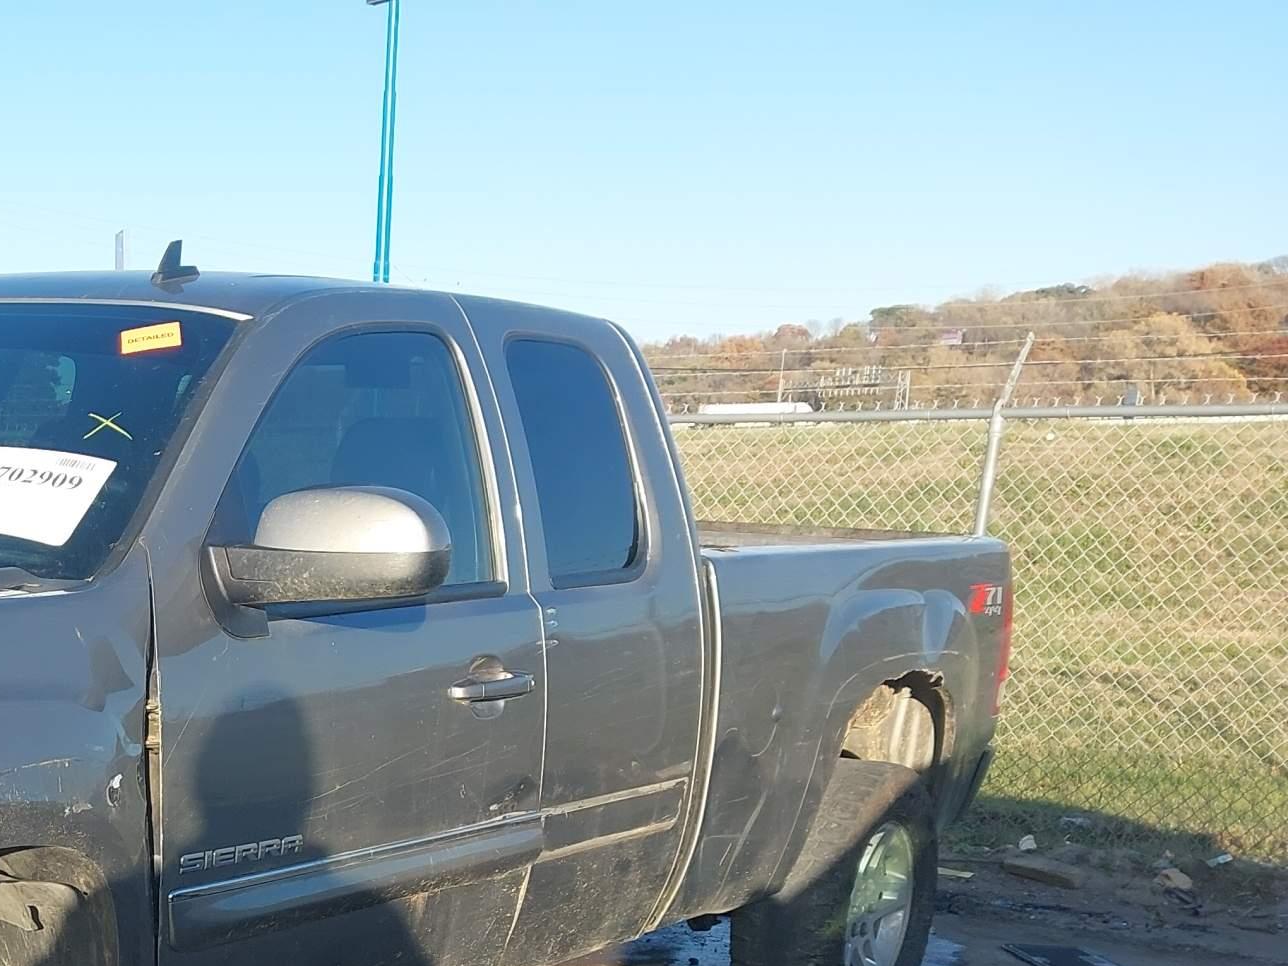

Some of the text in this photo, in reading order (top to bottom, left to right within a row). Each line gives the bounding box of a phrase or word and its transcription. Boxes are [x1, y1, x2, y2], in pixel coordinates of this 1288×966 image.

[127, 332, 174, 344] DETAILED
[968, 583, 1003, 614] Z71
[179, 834, 304, 875] SIERRA
